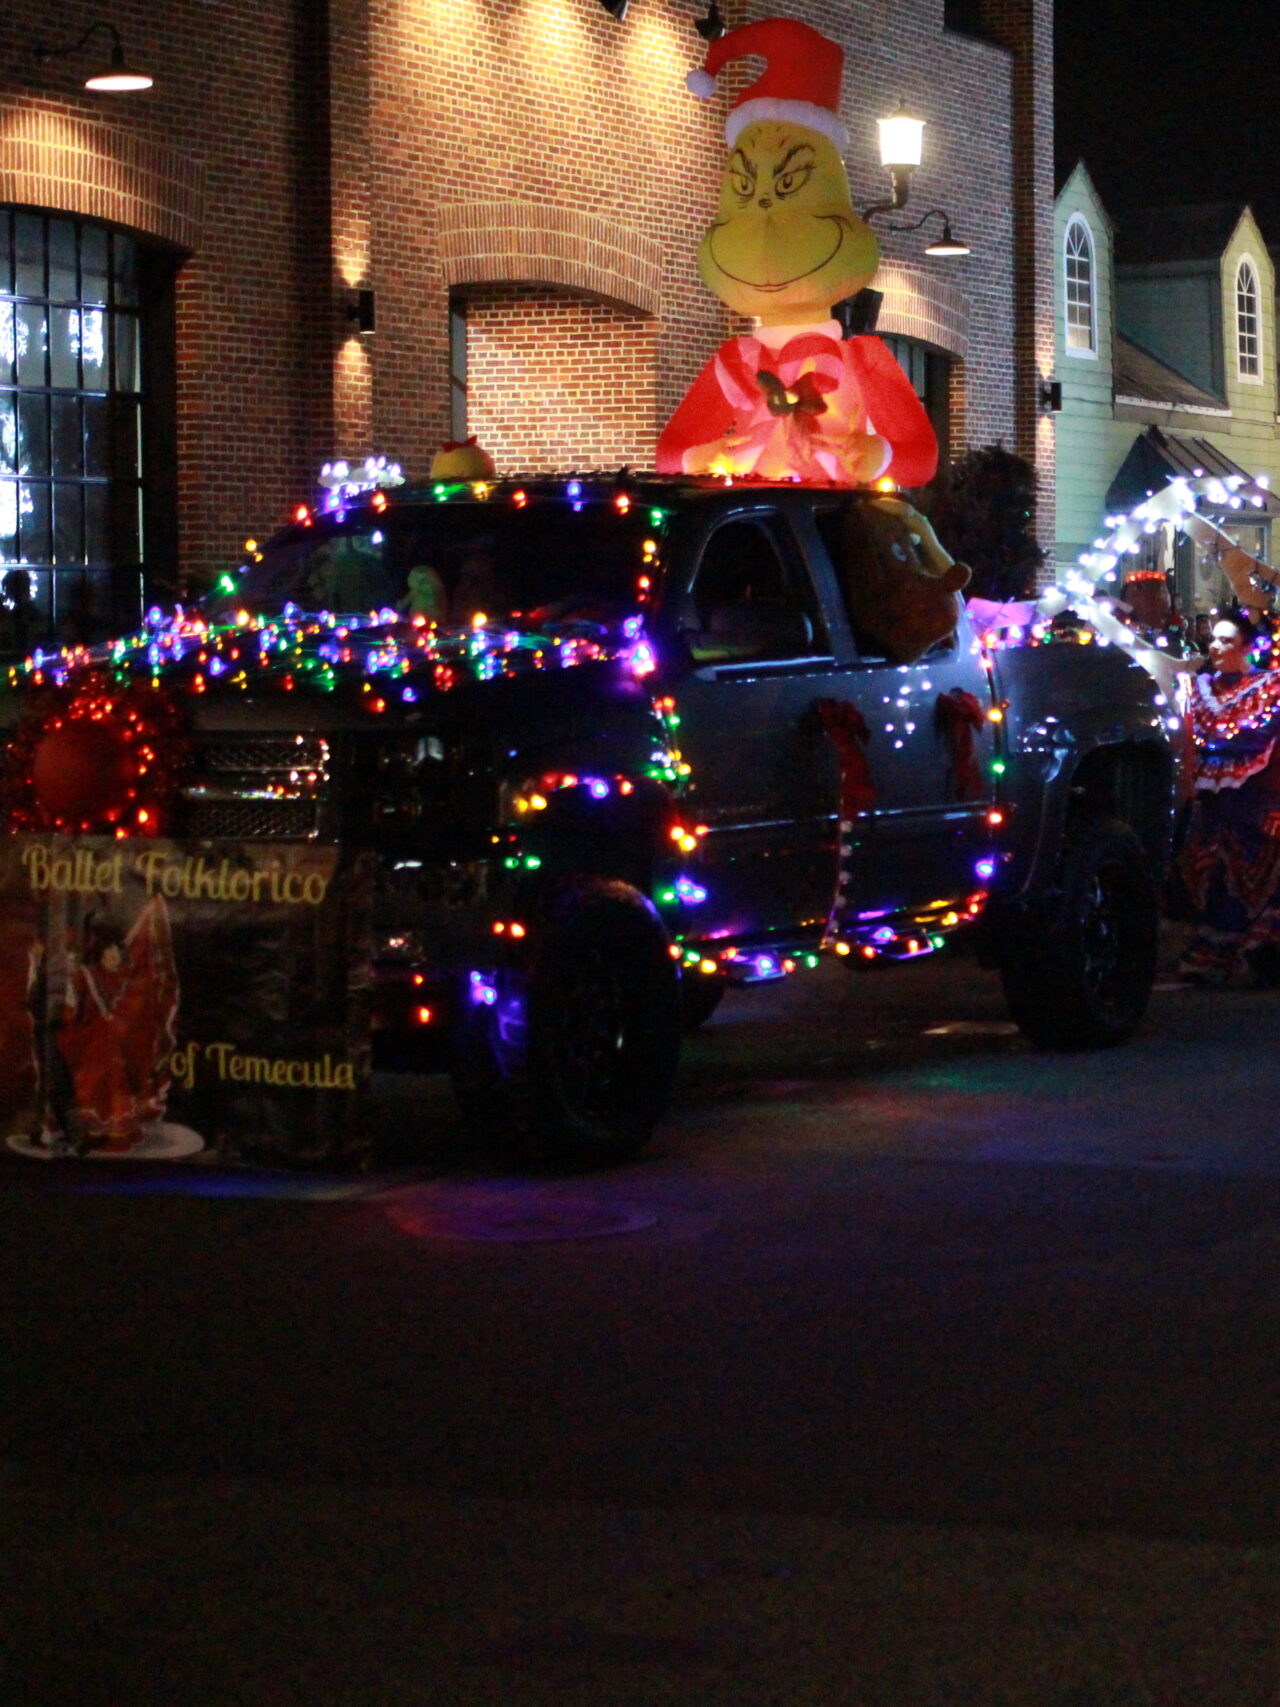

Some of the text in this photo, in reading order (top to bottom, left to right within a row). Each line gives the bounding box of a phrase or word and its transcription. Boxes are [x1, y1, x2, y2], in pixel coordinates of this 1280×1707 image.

[23, 845, 328, 905] Ballet Folklorico
[157, 1042, 356, 1090] of Temecula
